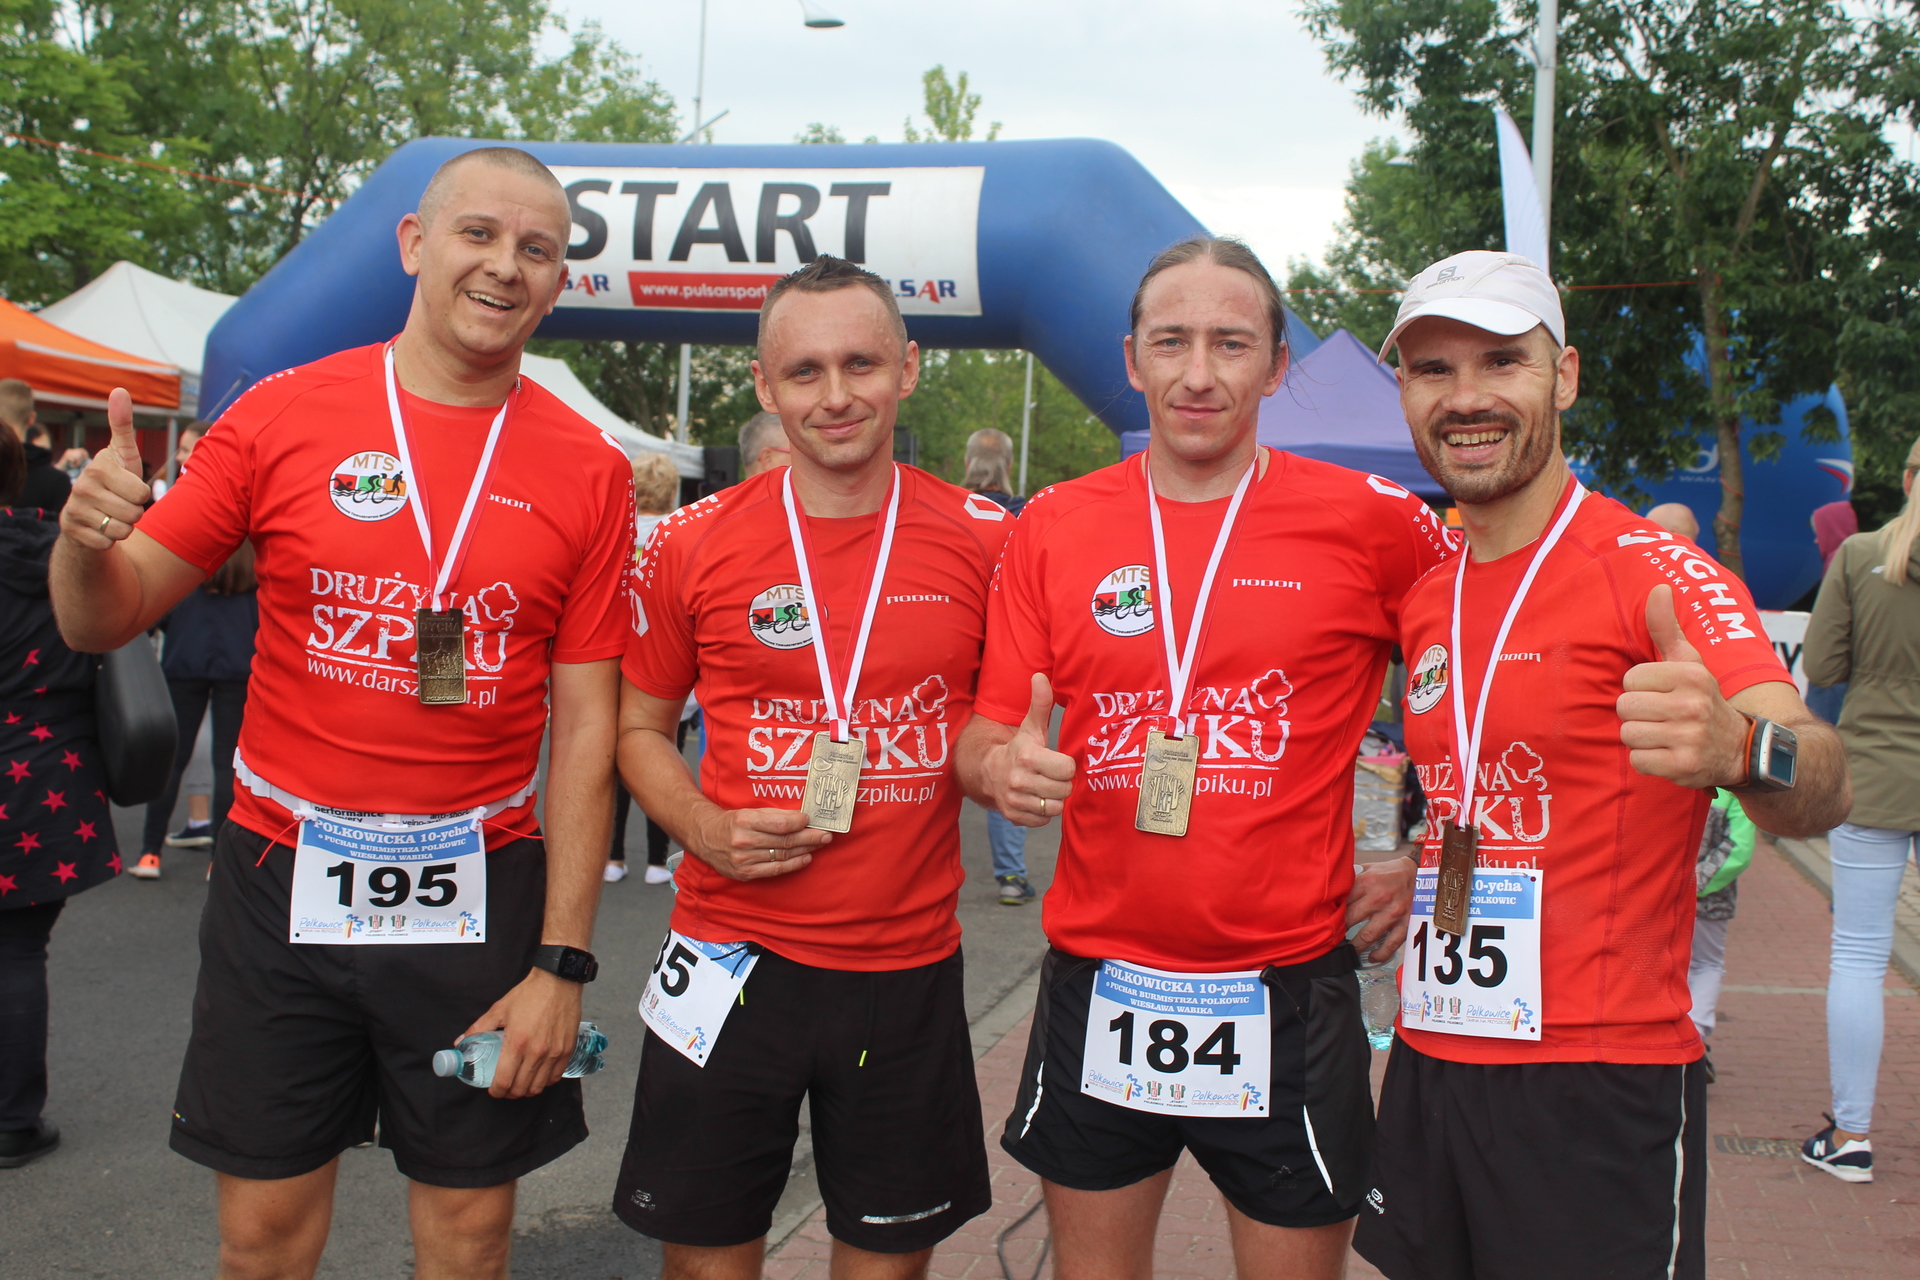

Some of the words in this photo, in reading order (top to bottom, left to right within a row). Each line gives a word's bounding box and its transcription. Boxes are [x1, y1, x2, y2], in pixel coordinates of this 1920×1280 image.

[565, 179, 892, 264] START
[352, 454, 395, 472] MTS
[646, 530, 672, 588] POLSKA
[1110, 567, 1150, 586] MTS
[766, 587, 806, 601] MTS
[1642, 551, 1690, 594] POLSKA
[1691, 601, 1723, 645] MIEDŹ
[1658, 545, 1756, 639] KGHM
[1421, 648, 1443, 666] MTS
[314, 820, 416, 844] POLKOWICKA
[420, 825, 470, 843] 10-ycha
[324, 835, 358, 849] PUCHAR
[360, 844, 419, 853] BURMISTRZA
[421, 838, 467, 852] POLKOWIC
[350, 850, 397, 861] WIESŁAWA
[399, 853, 433, 861] WABIKA
[326, 861, 457, 908] 195
[300, 917, 344, 929] Polkowice
[412, 918, 457, 929] Polkowice
[1413, 921, 1508, 988] 135
[1104, 964, 1194, 993] POLKOWICKA
[1199, 982, 1255, 996] 10-ycha
[1110, 983, 1138, 996] PUCHAR
[1139, 990, 1199, 1004] BURMISTRZA
[1200, 996, 1249, 1005] POLKOWIC
[1130, 999, 1174, 1012] WIESŁAWA
[1177, 1006, 1213, 1014] WABIKA
[1466, 1005, 1511, 1018] Polkowice
[1109, 1011, 1240, 1075] 184
[1089, 1070, 1124, 1088] Polkowice
[1191, 1090, 1240, 1100] Polkowice
